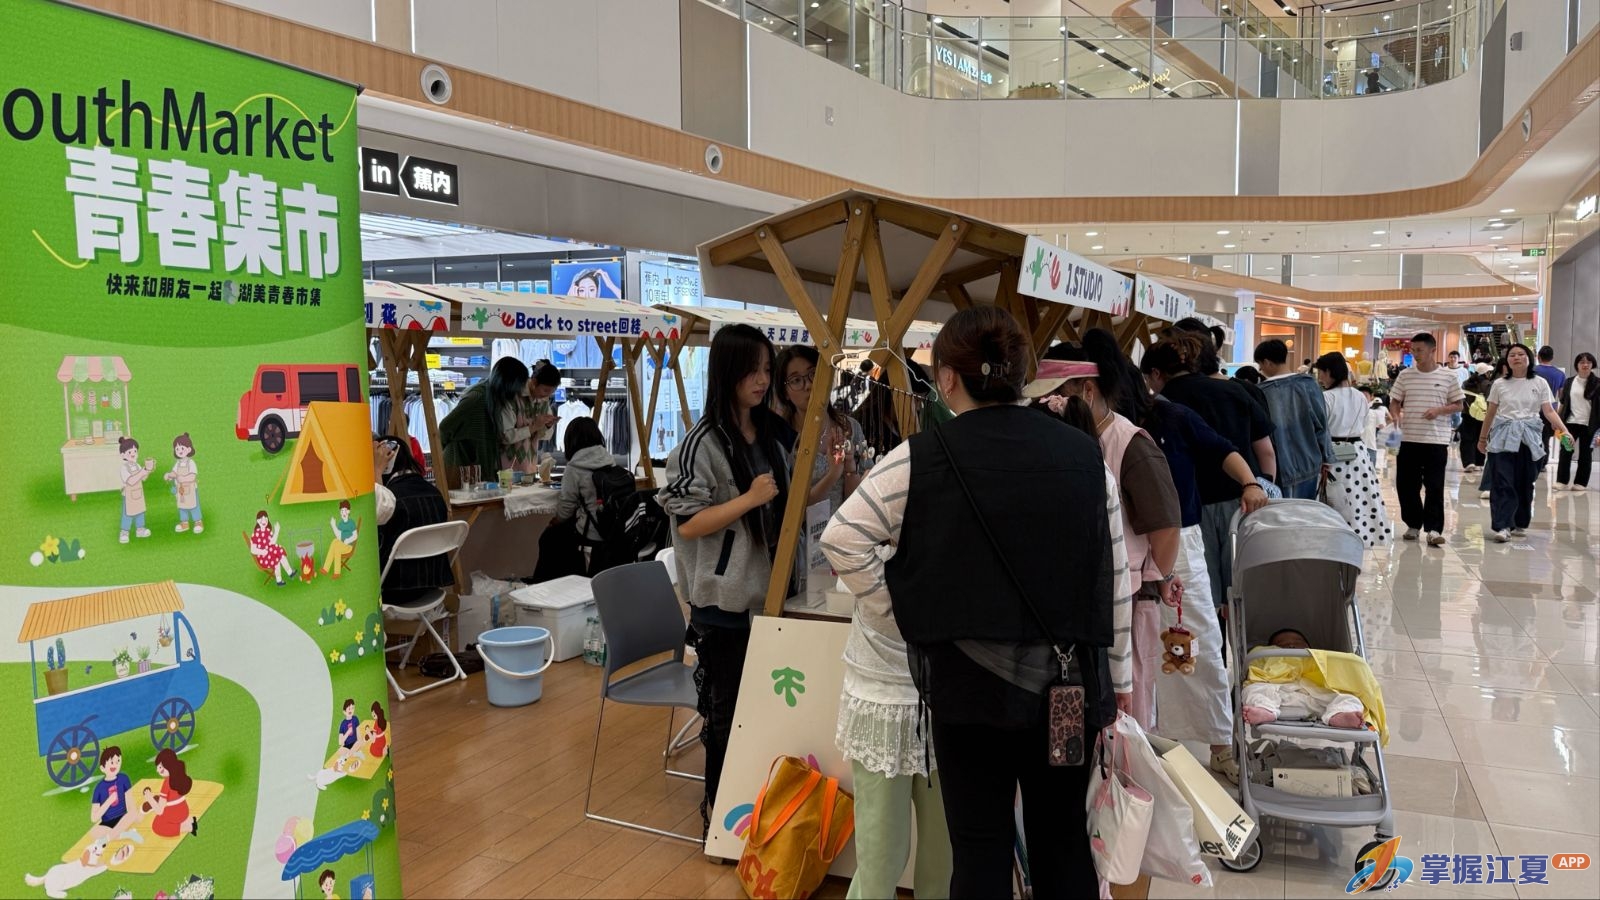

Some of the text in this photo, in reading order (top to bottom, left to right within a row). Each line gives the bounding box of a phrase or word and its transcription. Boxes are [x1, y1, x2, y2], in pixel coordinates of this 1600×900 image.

[935, 45, 953, 66] YES
[957, 57, 972, 80] AM
[2, 79, 335, 163] outhMarket
[371, 158, 392, 185] in
[412, 166, 452, 195] 蕉内
[65, 145, 340, 280] 青春集市
[106, 272, 322, 307] 快来和朋友一起湖美青春市集
[515, 312, 552, 331] Back
[557, 316, 574, 332] to
